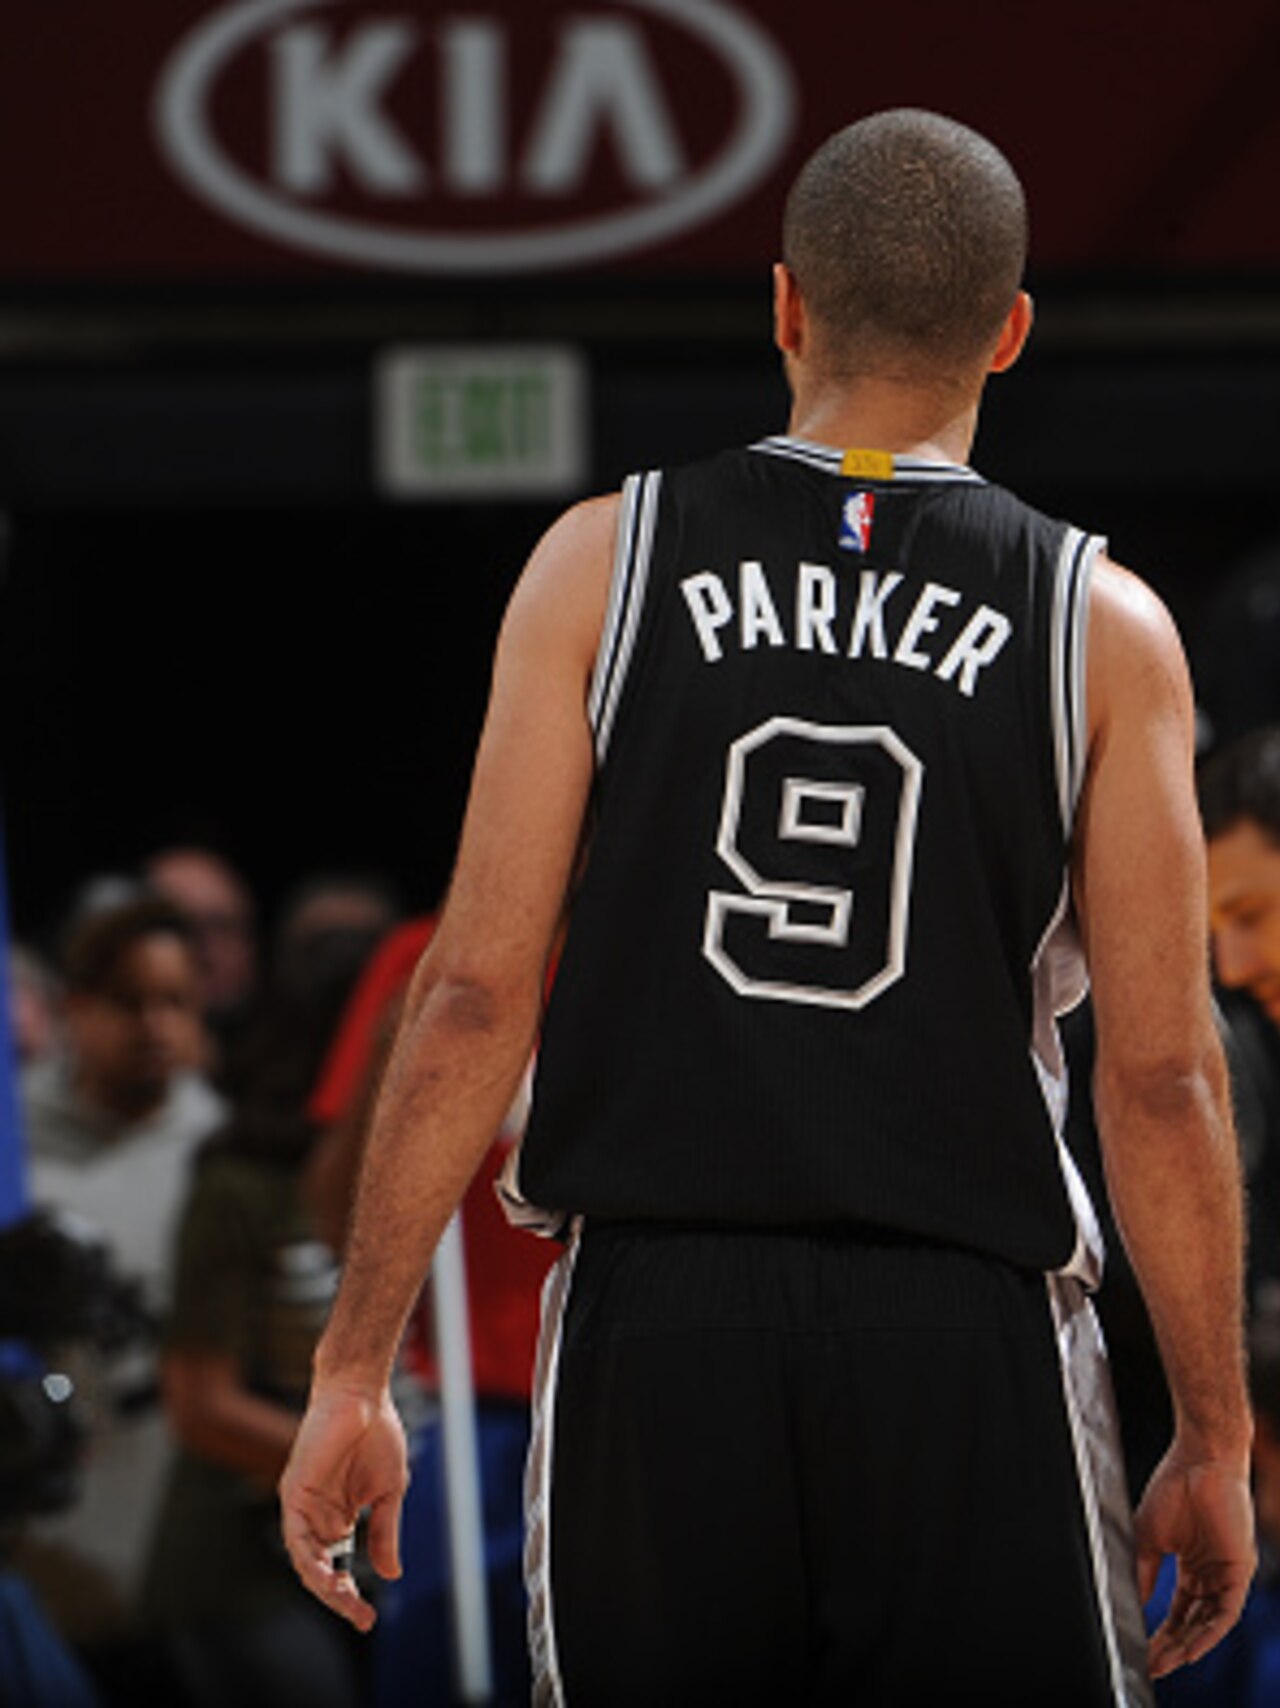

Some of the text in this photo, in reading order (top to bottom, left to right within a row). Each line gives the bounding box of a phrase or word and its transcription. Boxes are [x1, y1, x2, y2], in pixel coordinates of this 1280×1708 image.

[273, 18, 684, 195] KIA
[415, 371, 553, 470] EXIT
[681, 561, 1012, 697] PARKER
[703, 716, 923, 1008] 9
